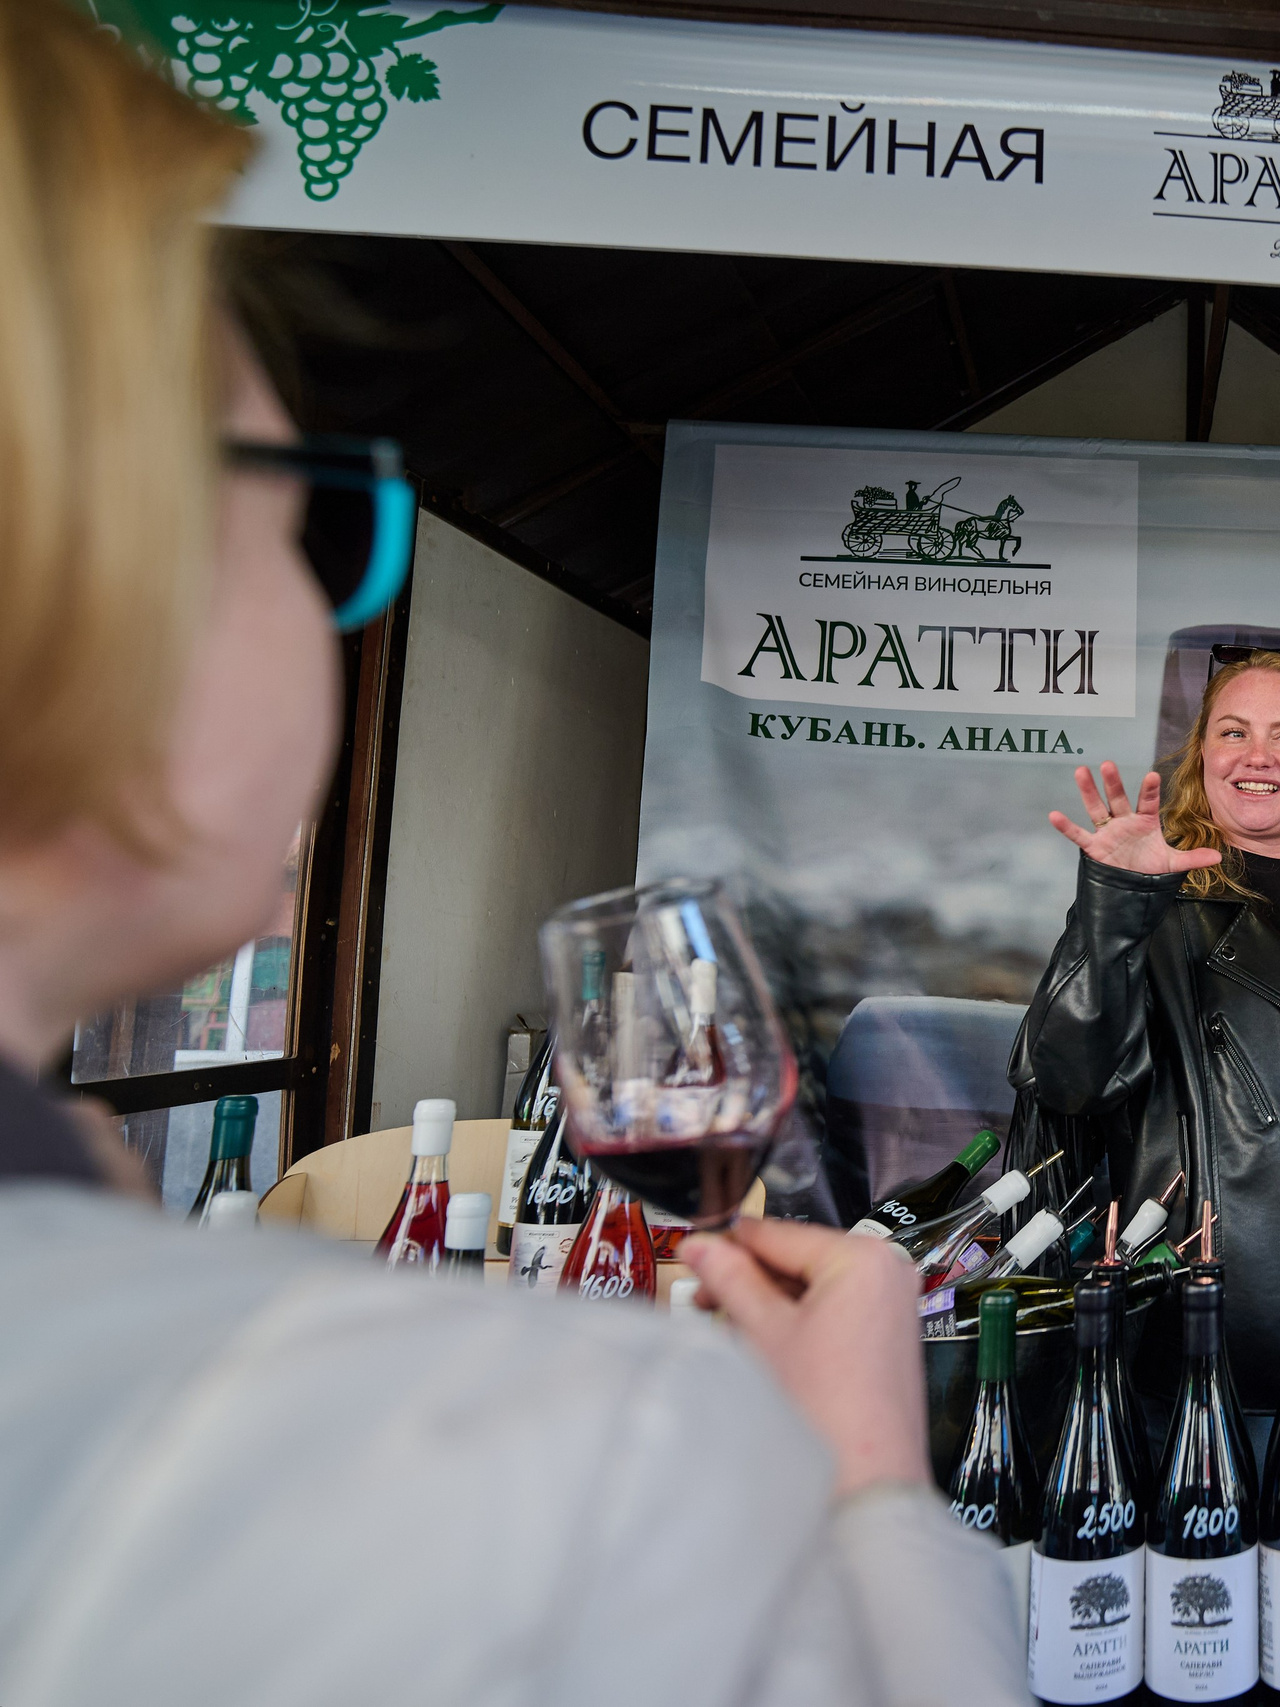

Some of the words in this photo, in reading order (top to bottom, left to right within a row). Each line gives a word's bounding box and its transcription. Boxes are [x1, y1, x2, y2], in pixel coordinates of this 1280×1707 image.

[582, 99, 1045, 185] СЕМЕЙНАЯ
[798, 571, 908, 592] СЕМЕЙНАЯ
[915, 576, 1052, 597] ВИНОДЕЛЬНЯ
[737, 612, 1100, 695] АРАТТИ
[747, 711, 925, 749] КУБАНЬ.
[938, 725, 1084, 754] АНАПА.
[526, 1180, 577, 1205] 1600
[877, 1199, 917, 1225] 1600
[582, 1274, 634, 1300] 1600
[1076, 1499, 1135, 1540] 2500
[1182, 1504, 1239, 1540] 1800
[1073, 1634, 1128, 1657] АРАТТИ
[1174, 1637, 1230, 1655] АРАТТИ
